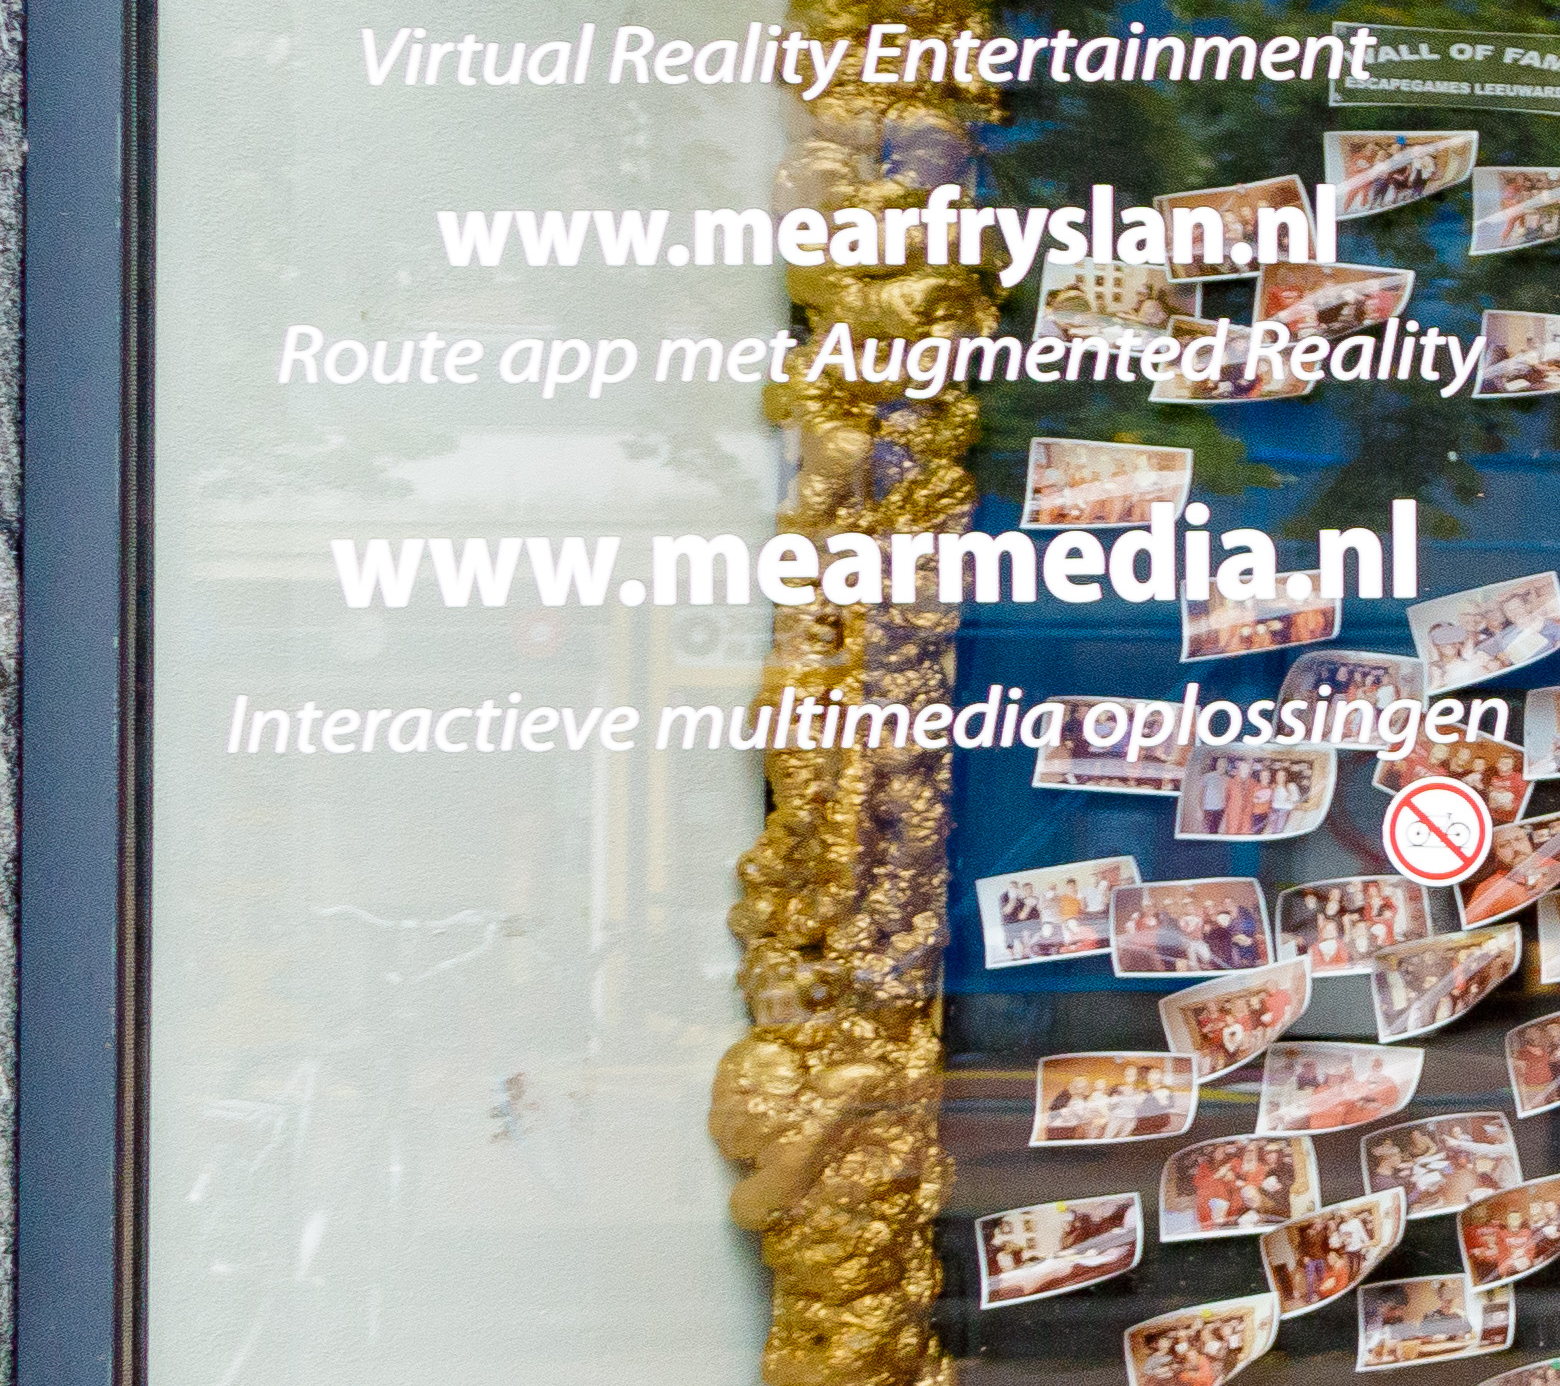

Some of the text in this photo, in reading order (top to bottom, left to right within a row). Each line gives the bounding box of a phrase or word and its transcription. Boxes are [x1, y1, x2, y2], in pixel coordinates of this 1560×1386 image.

[361, 21, 1378, 101] Virtual Reality Entertainment
[1344, 75, 1472, 95] ESCAPEGAMES
[1450, 43, 1495, 61] OF
[436, 183, 1338, 287] www.mearfryslan.nl
[278, 316, 1486, 400] Route app met Augmented Reality
[329, 498, 1418, 610] www.mearmedia.nl
[227, 682, 1509, 763] Interactieve multimedia oplossingen
